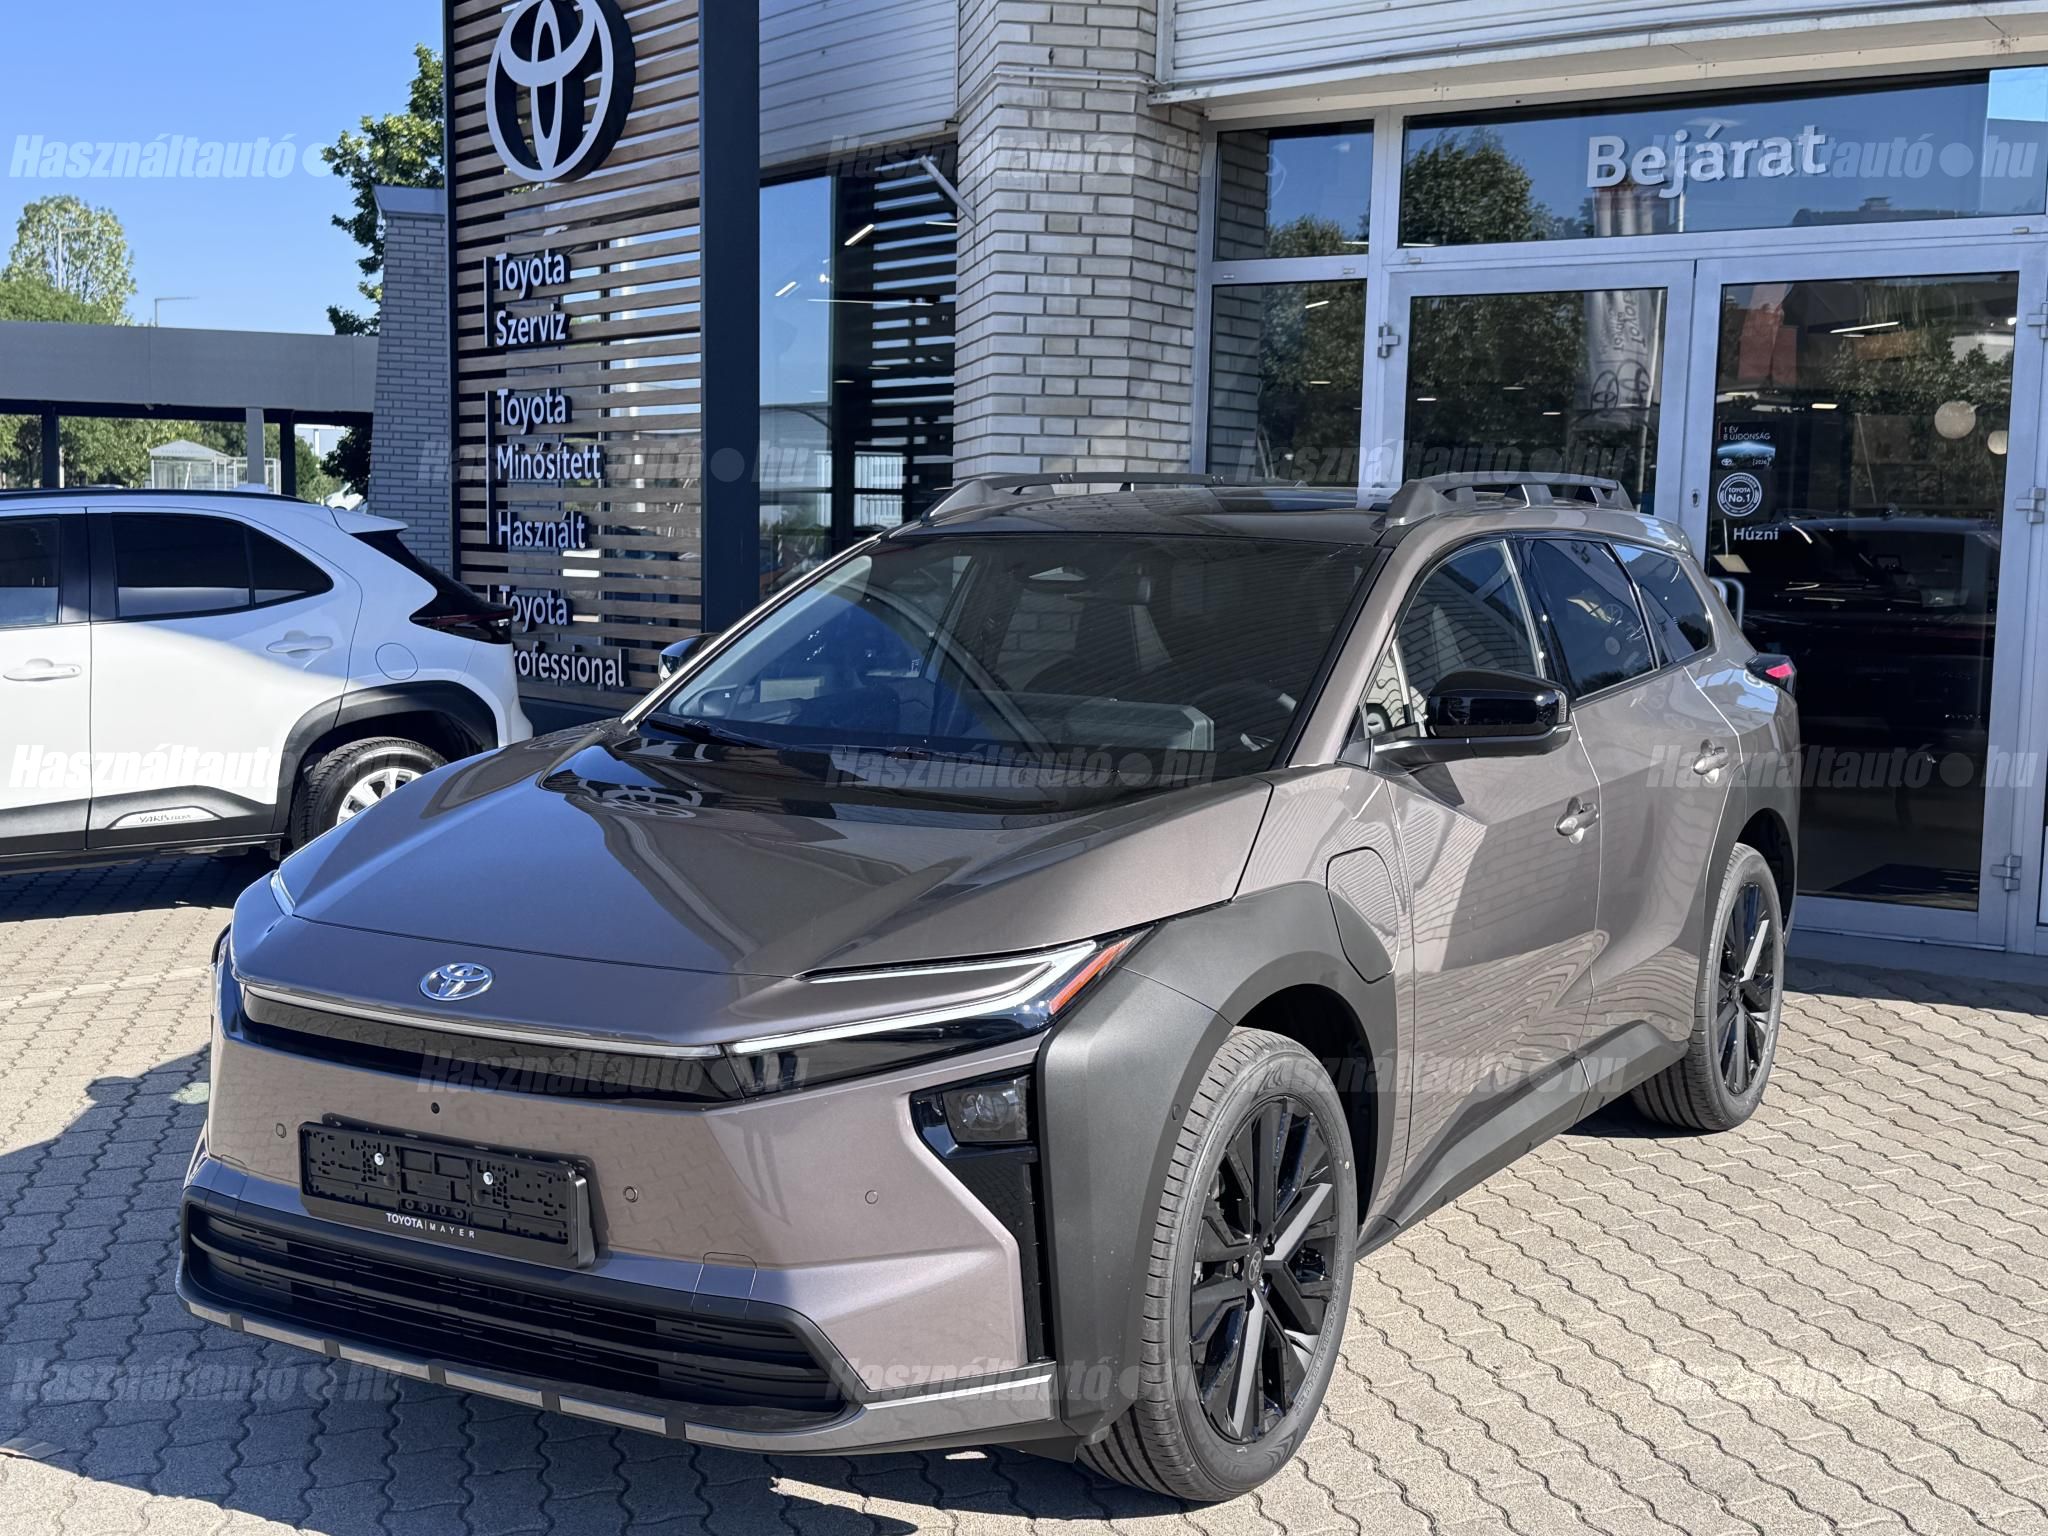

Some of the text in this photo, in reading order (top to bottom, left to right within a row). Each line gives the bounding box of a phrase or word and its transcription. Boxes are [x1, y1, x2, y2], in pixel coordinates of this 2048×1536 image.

[1586, 122, 1828, 199] Bejárat
[495, 249, 565, 300] Toyota
[496, 303, 566, 346] Szerviz
[497, 388, 567, 435] Toyota
[497, 442, 601, 480] Minősített
[498, 511, 586, 549] Használt
[1733, 526, 1780, 541] Húzni
[498, 585, 568, 632] Toyota
[513, 640, 625, 688] ofessional
[385, 1212, 476, 1240] TOYOTA MAYER
